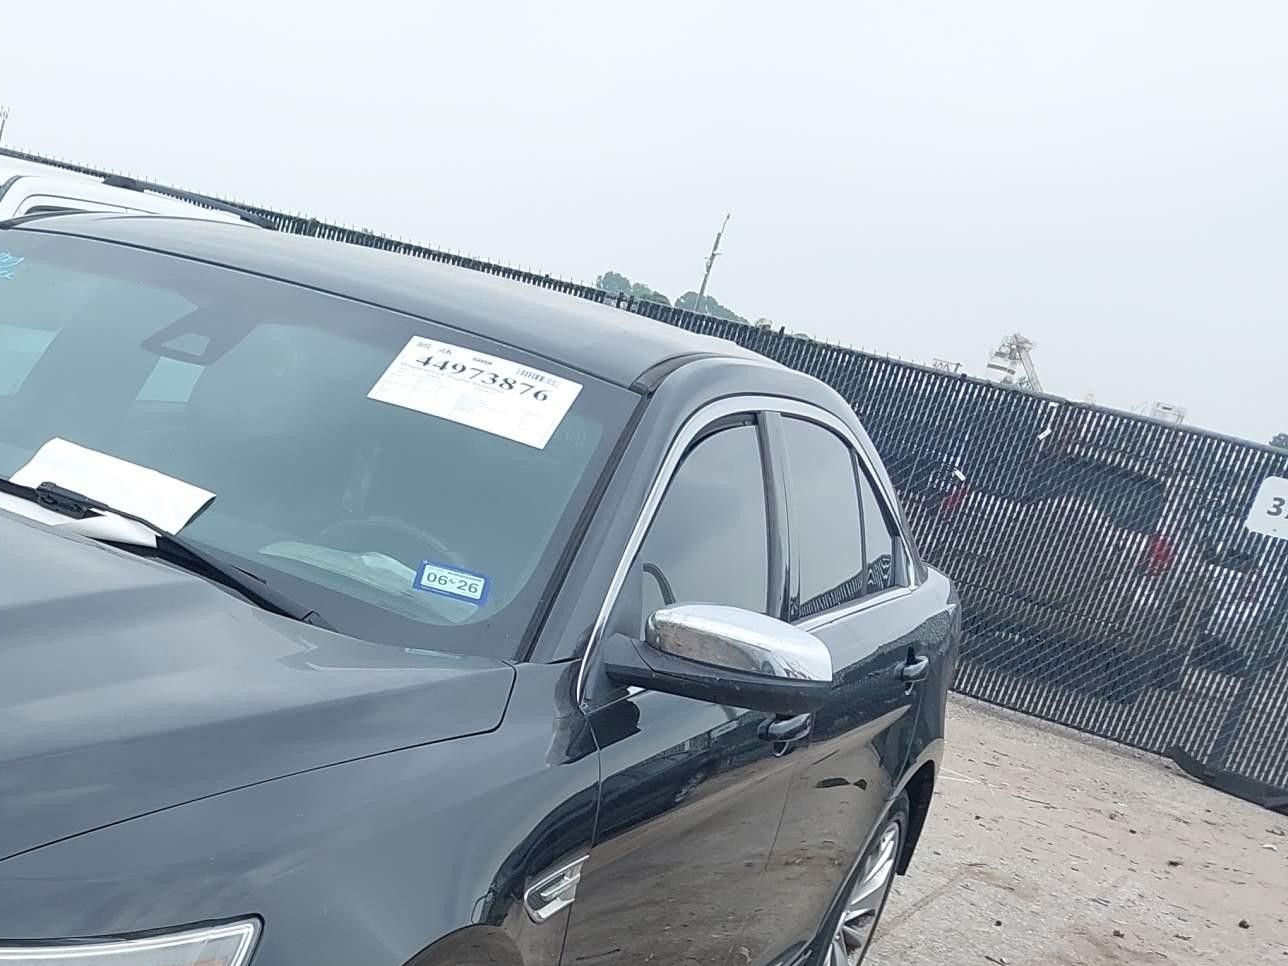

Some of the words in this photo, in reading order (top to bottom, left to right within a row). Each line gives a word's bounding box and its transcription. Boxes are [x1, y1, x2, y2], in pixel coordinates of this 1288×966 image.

[415, 354, 553, 402] 44973876
[1266, 496, 1288, 519] 3
[426, 572, 449, 586] 06
[455, 579, 480, 594] 26
